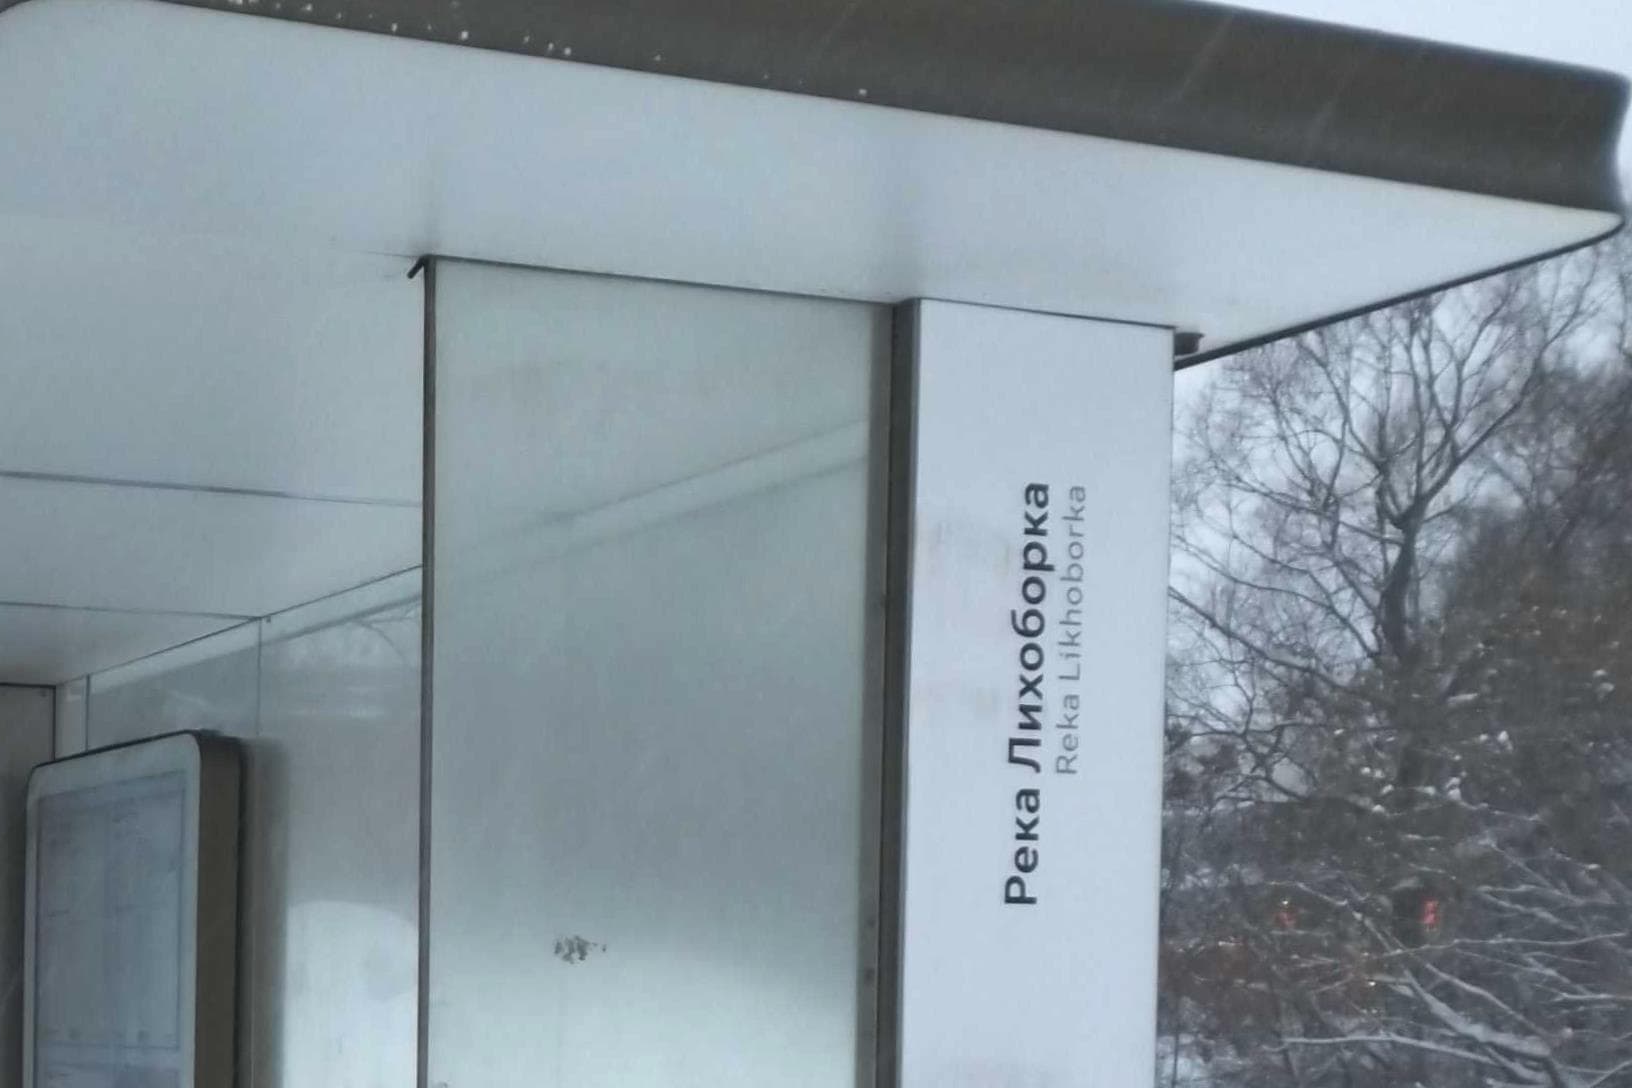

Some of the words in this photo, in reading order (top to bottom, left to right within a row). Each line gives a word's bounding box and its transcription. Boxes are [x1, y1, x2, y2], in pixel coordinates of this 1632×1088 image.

[1007, 481, 1055, 774] Лихоборка
[1057, 484, 1087, 682] Likhoborka
[1055, 692, 1081, 775] Reka
[1004, 787, 1041, 906] Река
